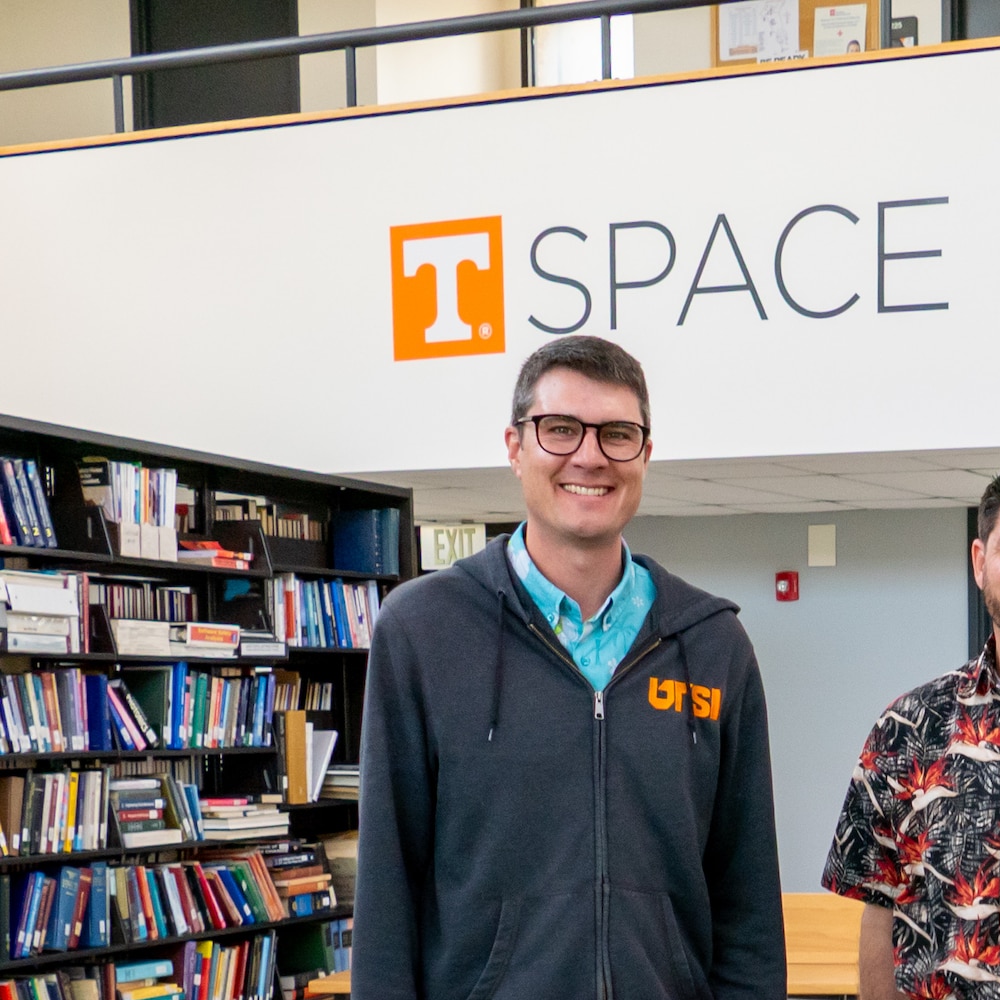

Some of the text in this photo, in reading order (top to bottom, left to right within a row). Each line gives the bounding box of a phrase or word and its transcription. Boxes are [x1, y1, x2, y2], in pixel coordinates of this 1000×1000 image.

[528, 196, 949, 335] SPACE
[433, 527, 476, 565] EXIT
[648, 676, 721, 720] UTSI
